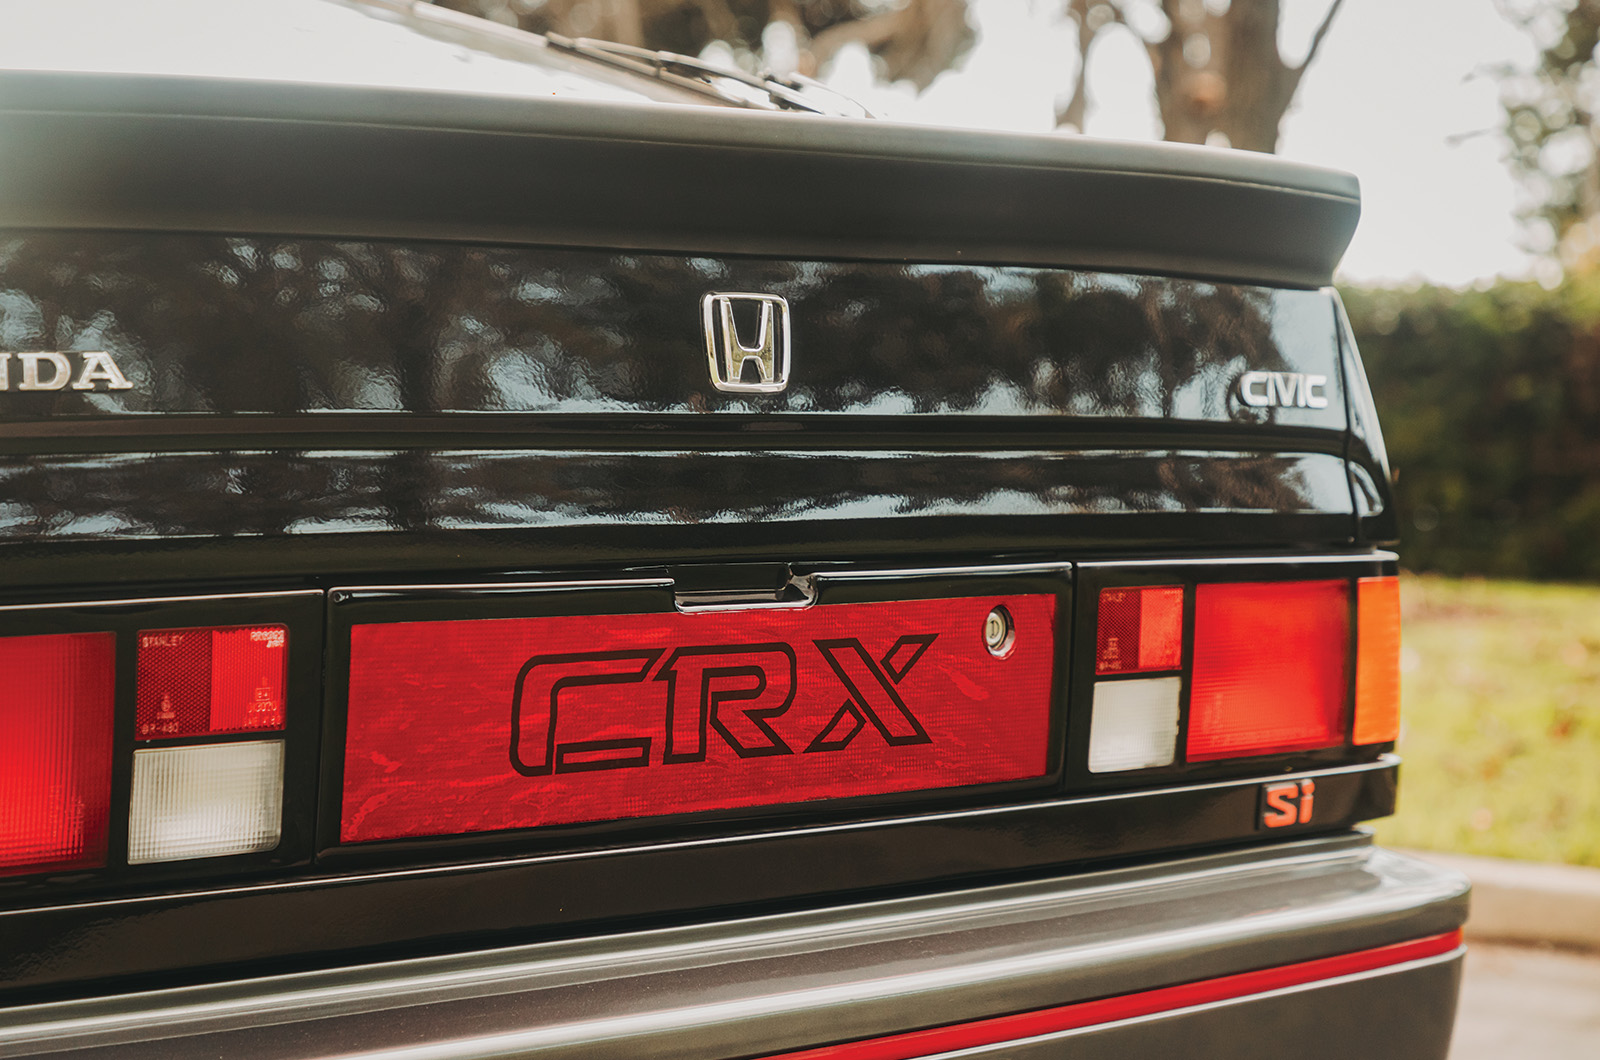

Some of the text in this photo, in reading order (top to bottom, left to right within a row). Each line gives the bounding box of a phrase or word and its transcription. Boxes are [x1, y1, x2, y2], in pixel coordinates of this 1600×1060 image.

[0, 351, 134, 391] DA
[1241, 371, 1329, 409] CIVIC
[142, 635, 184, 649] STANLEY
[509, 633, 940, 777] CRX
[1263, 778, 1316, 829] Si
